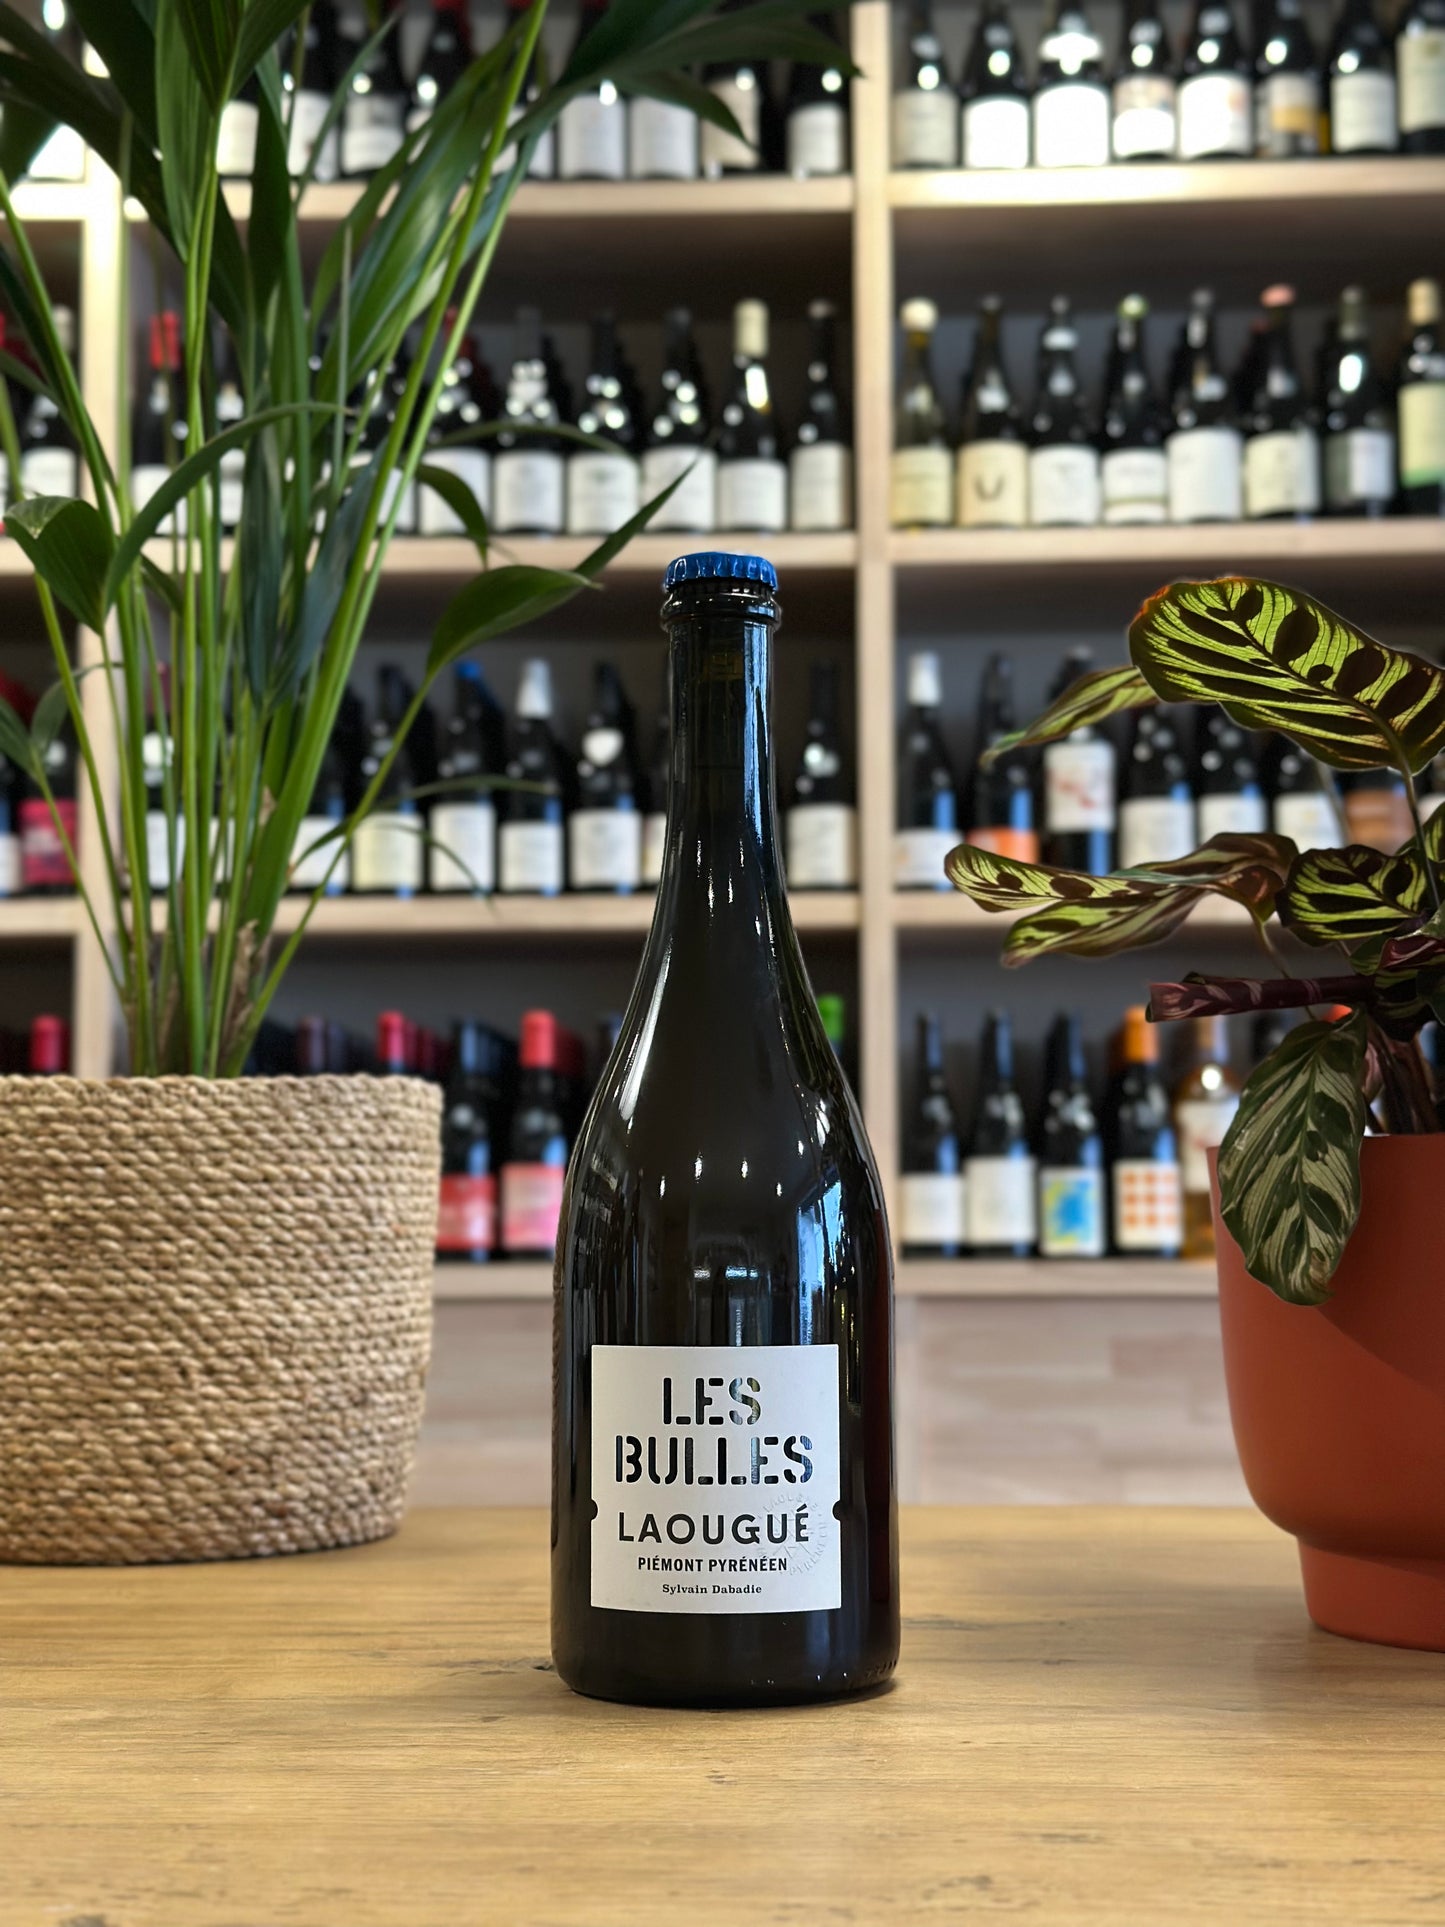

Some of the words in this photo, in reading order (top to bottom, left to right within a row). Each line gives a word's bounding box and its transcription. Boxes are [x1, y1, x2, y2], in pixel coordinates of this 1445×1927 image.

[663, 1377, 761, 1425] LES
[615, 1435, 813, 1485] BULLES
[618, 1503, 809, 1545] LAOUGUÉ
[637, 1555, 704, 1572] PIÉMONT
[708, 1555, 787, 1572] PYRÉNÉEN
[662, 1583, 708, 1595] Sylvain
[712, 1584, 762, 1594] Dabadie
